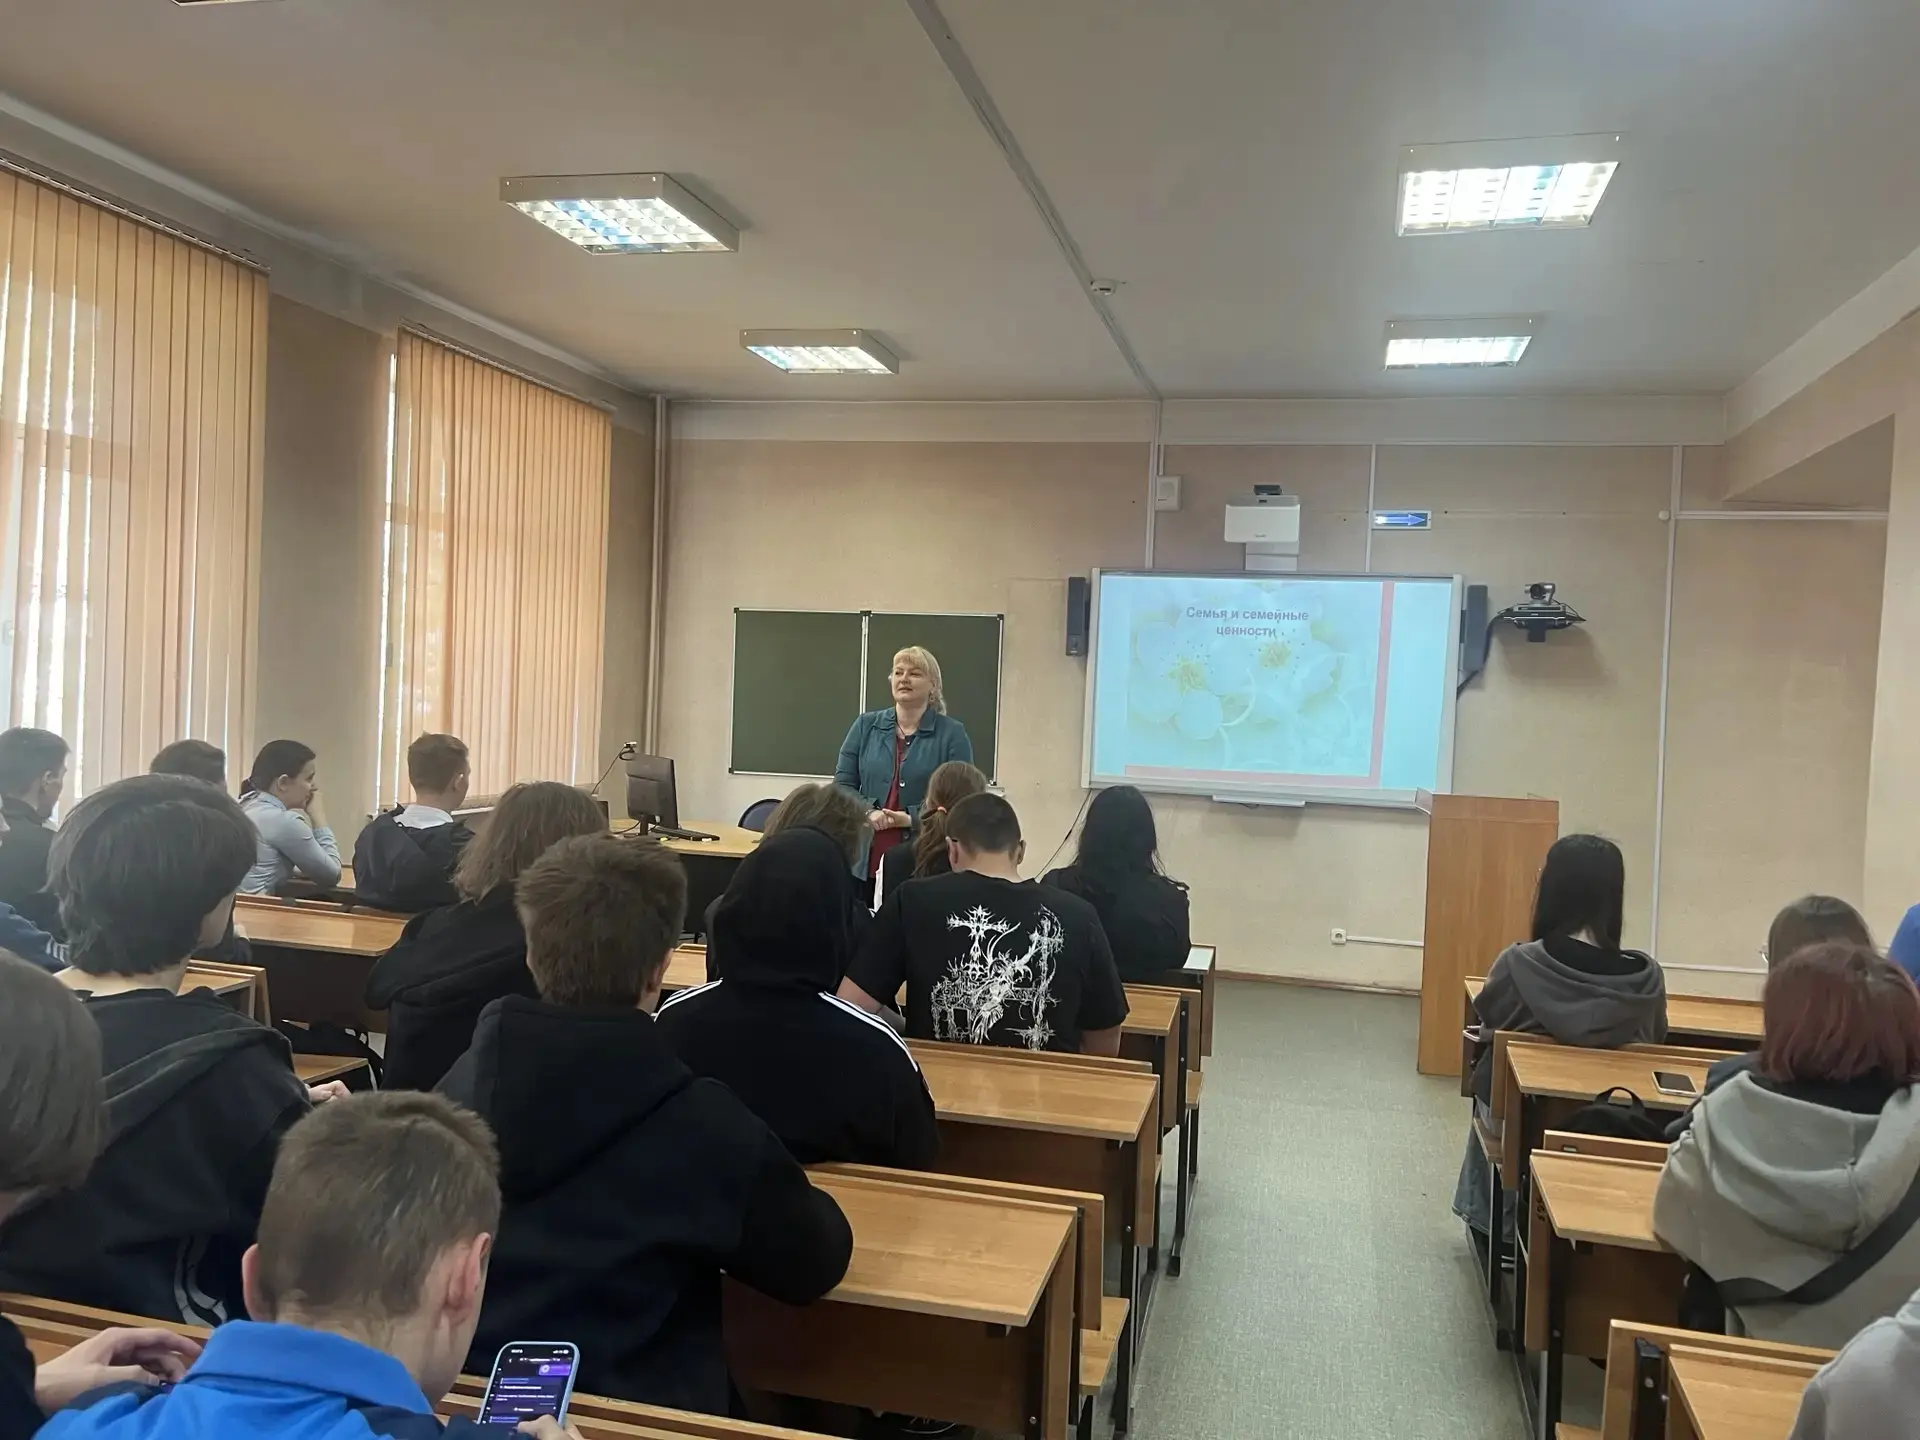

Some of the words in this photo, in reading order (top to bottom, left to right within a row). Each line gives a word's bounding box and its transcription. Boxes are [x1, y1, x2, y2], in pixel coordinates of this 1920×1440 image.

[1186, 606, 1227, 619] Семья
[1230, 609, 1239, 619] и
[1242, 608, 1309, 621] семейные
[1216, 625, 1276, 637] ценности
